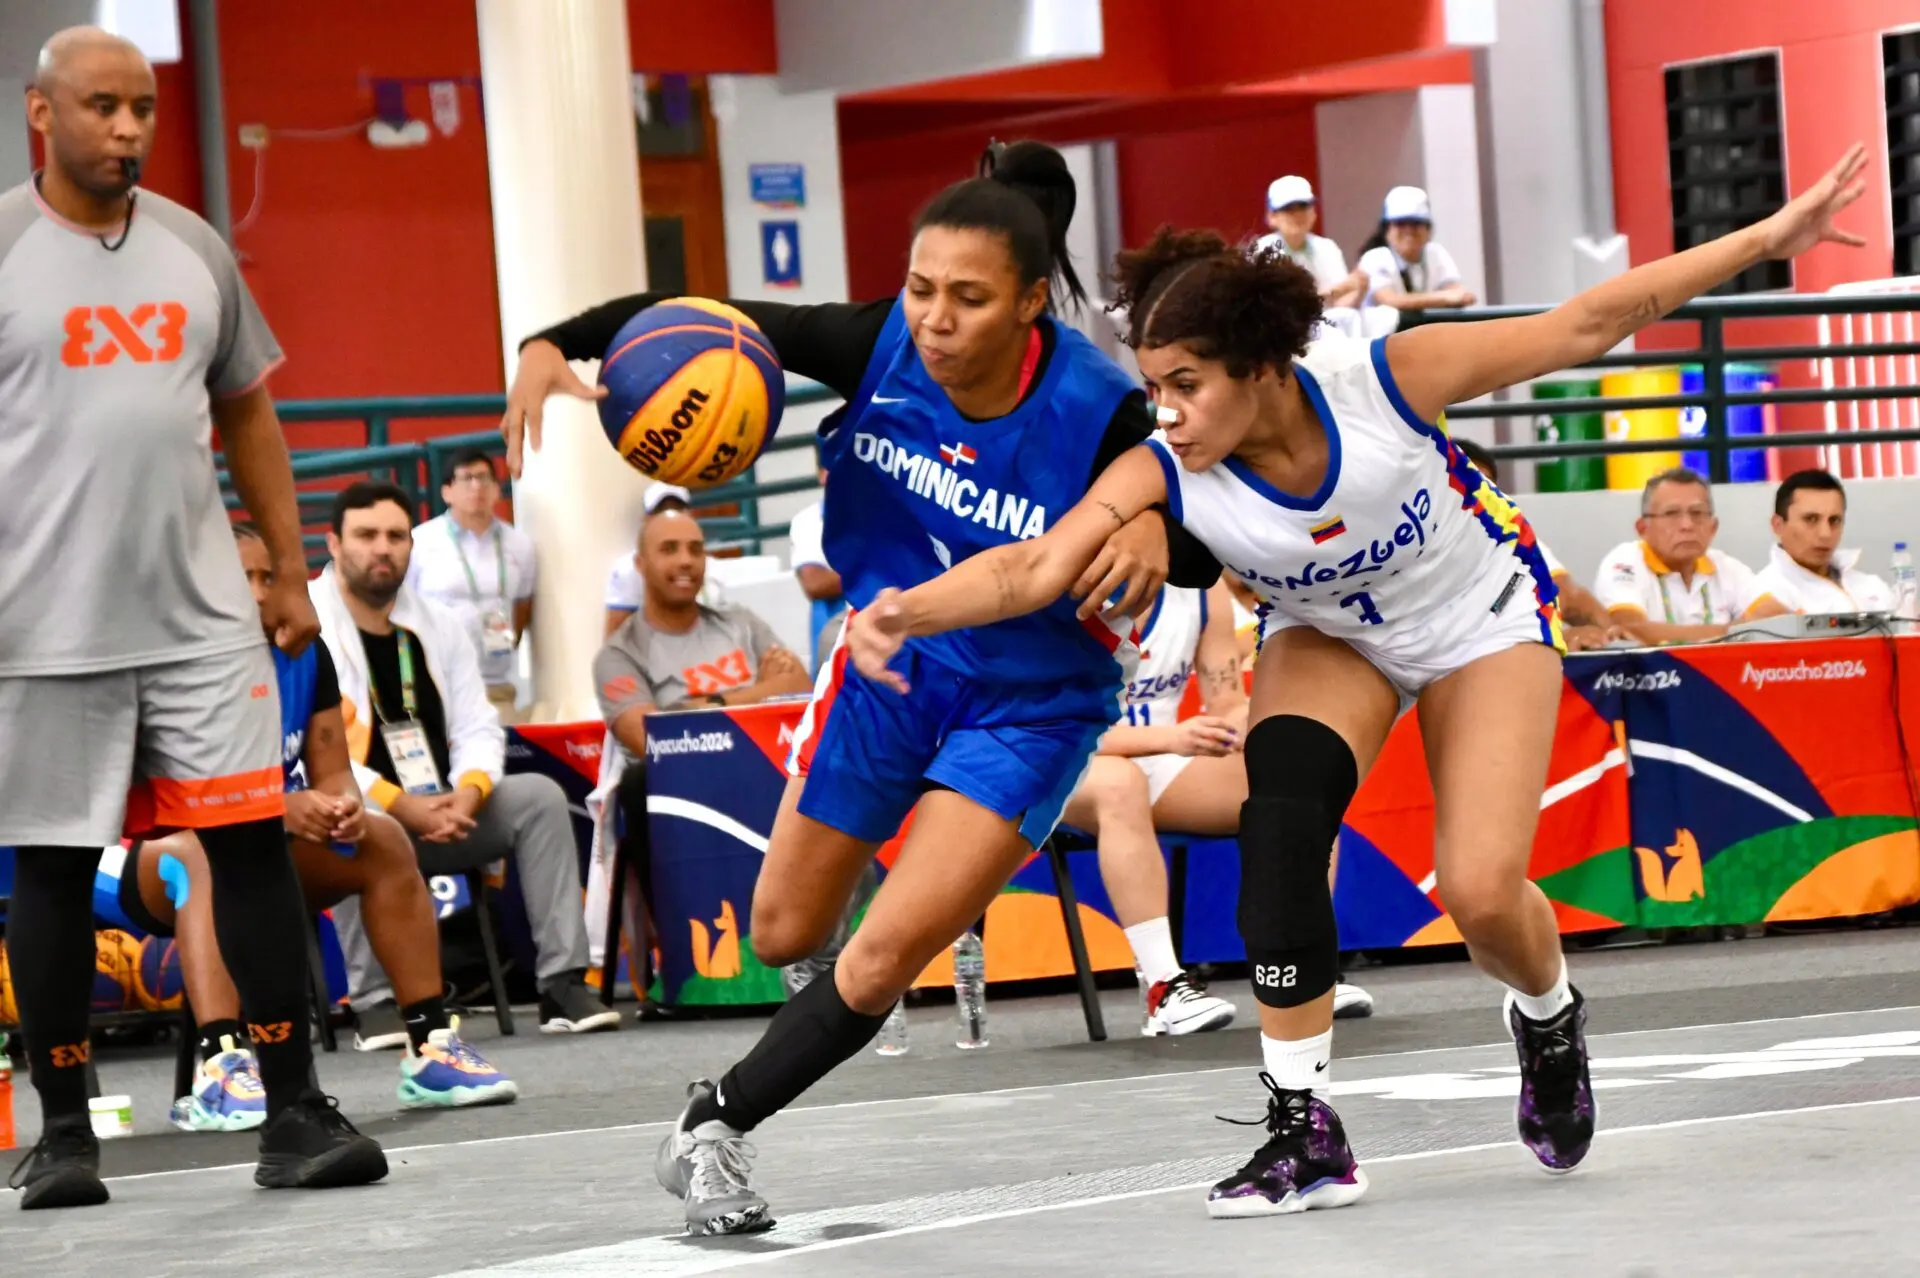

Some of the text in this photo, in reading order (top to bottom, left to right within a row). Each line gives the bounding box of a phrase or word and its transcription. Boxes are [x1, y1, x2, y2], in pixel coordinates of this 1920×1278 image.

[625, 388, 711, 476] Wilson
[853, 432, 1046, 540] DOMINICANA
[1340, 591, 1384, 626] 7
[1741, 658, 1867, 691] Ayacucho2024
[646, 729, 734, 764] Ayacucho2024
[1255, 963, 1298, 988] 622
